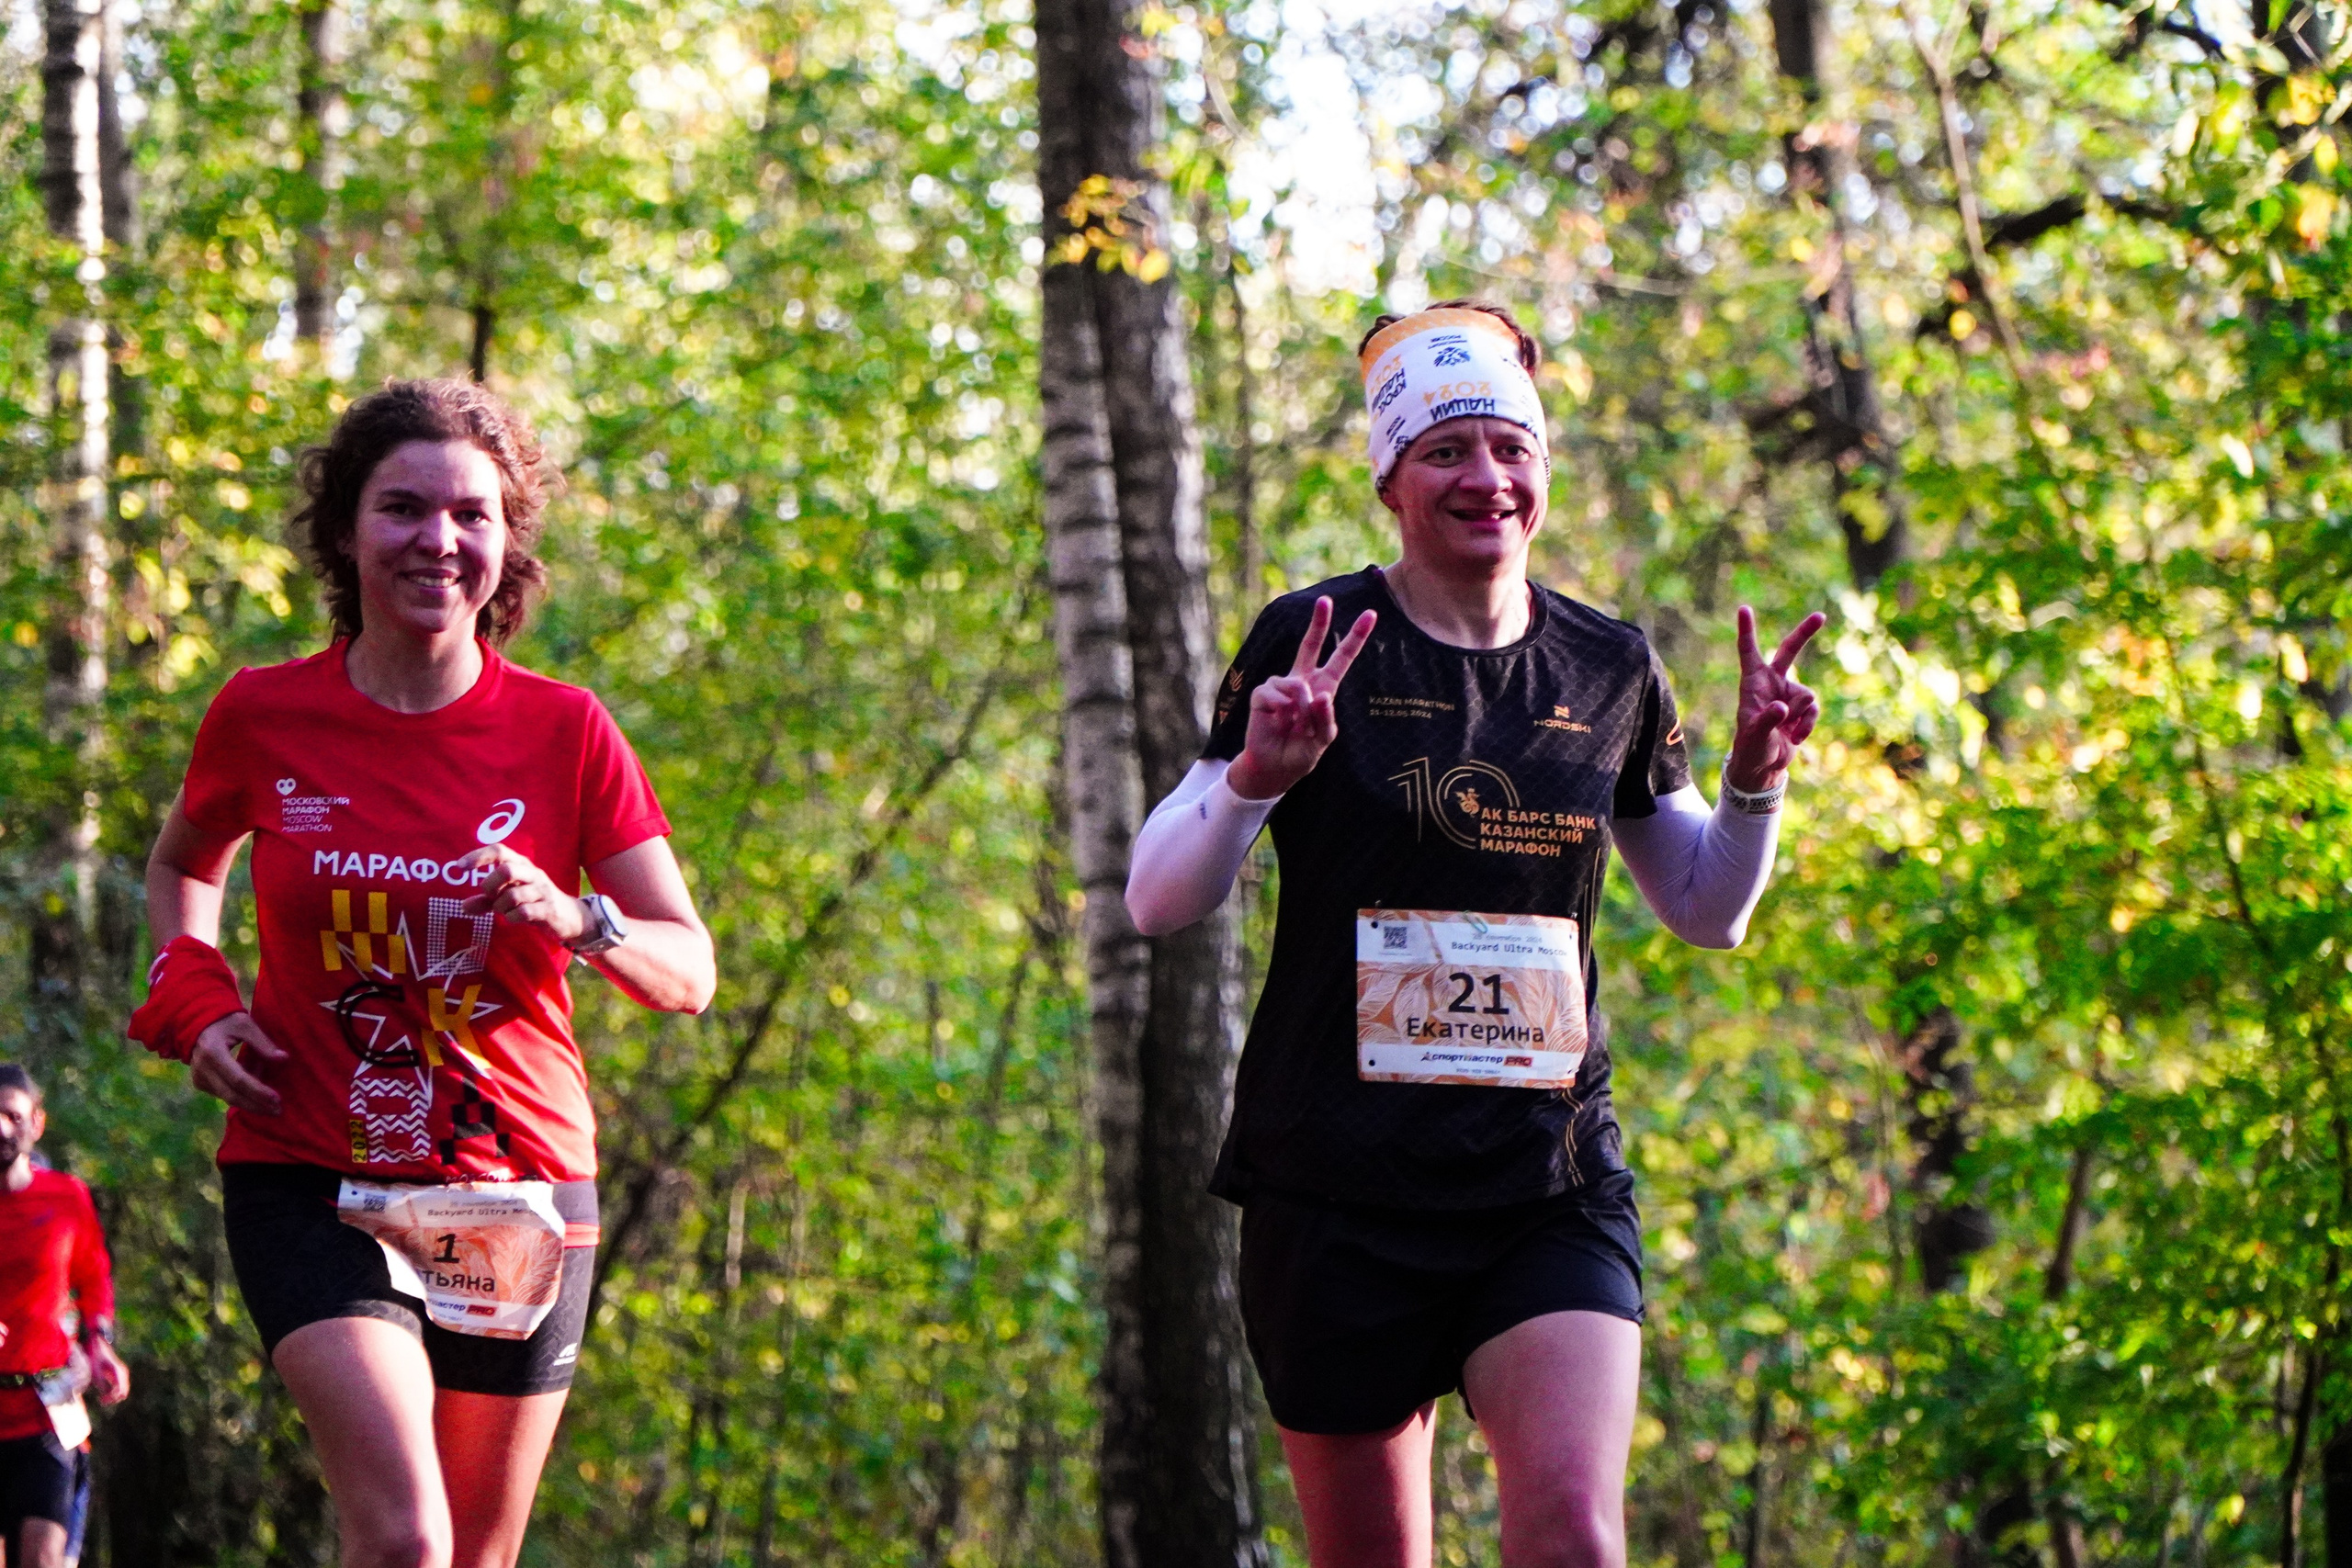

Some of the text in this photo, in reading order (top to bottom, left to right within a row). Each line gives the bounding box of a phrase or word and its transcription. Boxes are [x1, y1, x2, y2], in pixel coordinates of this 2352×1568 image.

[1423, 381, 1494, 408] 2024
[1430, 398, 1496, 422] НАЦИИ
[1369, 696, 1455, 711] KAZAN MARATHON
[1410, 709, 1432, 719] 2024
[1533, 718, 1591, 734] NORDSKI
[282, 796, 350, 807] МОСКОВСКИЙ
[282, 806, 330, 816] МАРАФОН
[1480, 807, 1596, 830] АК БАРС БАНК
[282, 815, 323, 825] MOSCOW
[282, 824, 333, 833] MARATHON
[1480, 822, 1583, 844] КАЗАНСКИЙ
[1480, 839, 1562, 857] МАРАФОН
[1452, 941, 1499, 953] Backyard
[1504, 943, 1533, 954] Ultra
[1449, 972, 1510, 1015] 21
[1408, 1017, 1544, 1044] Екатерина
[1431, 1052, 1533, 1067] спортмастер PRO
[350, 1119, 367, 1163] 2022
[427, 1209, 474, 1218] Backyard
[479, 1208, 508, 1216] Ultra
[434, 1233, 460, 1264] 1
[422, 1270, 495, 1292] тьяна
